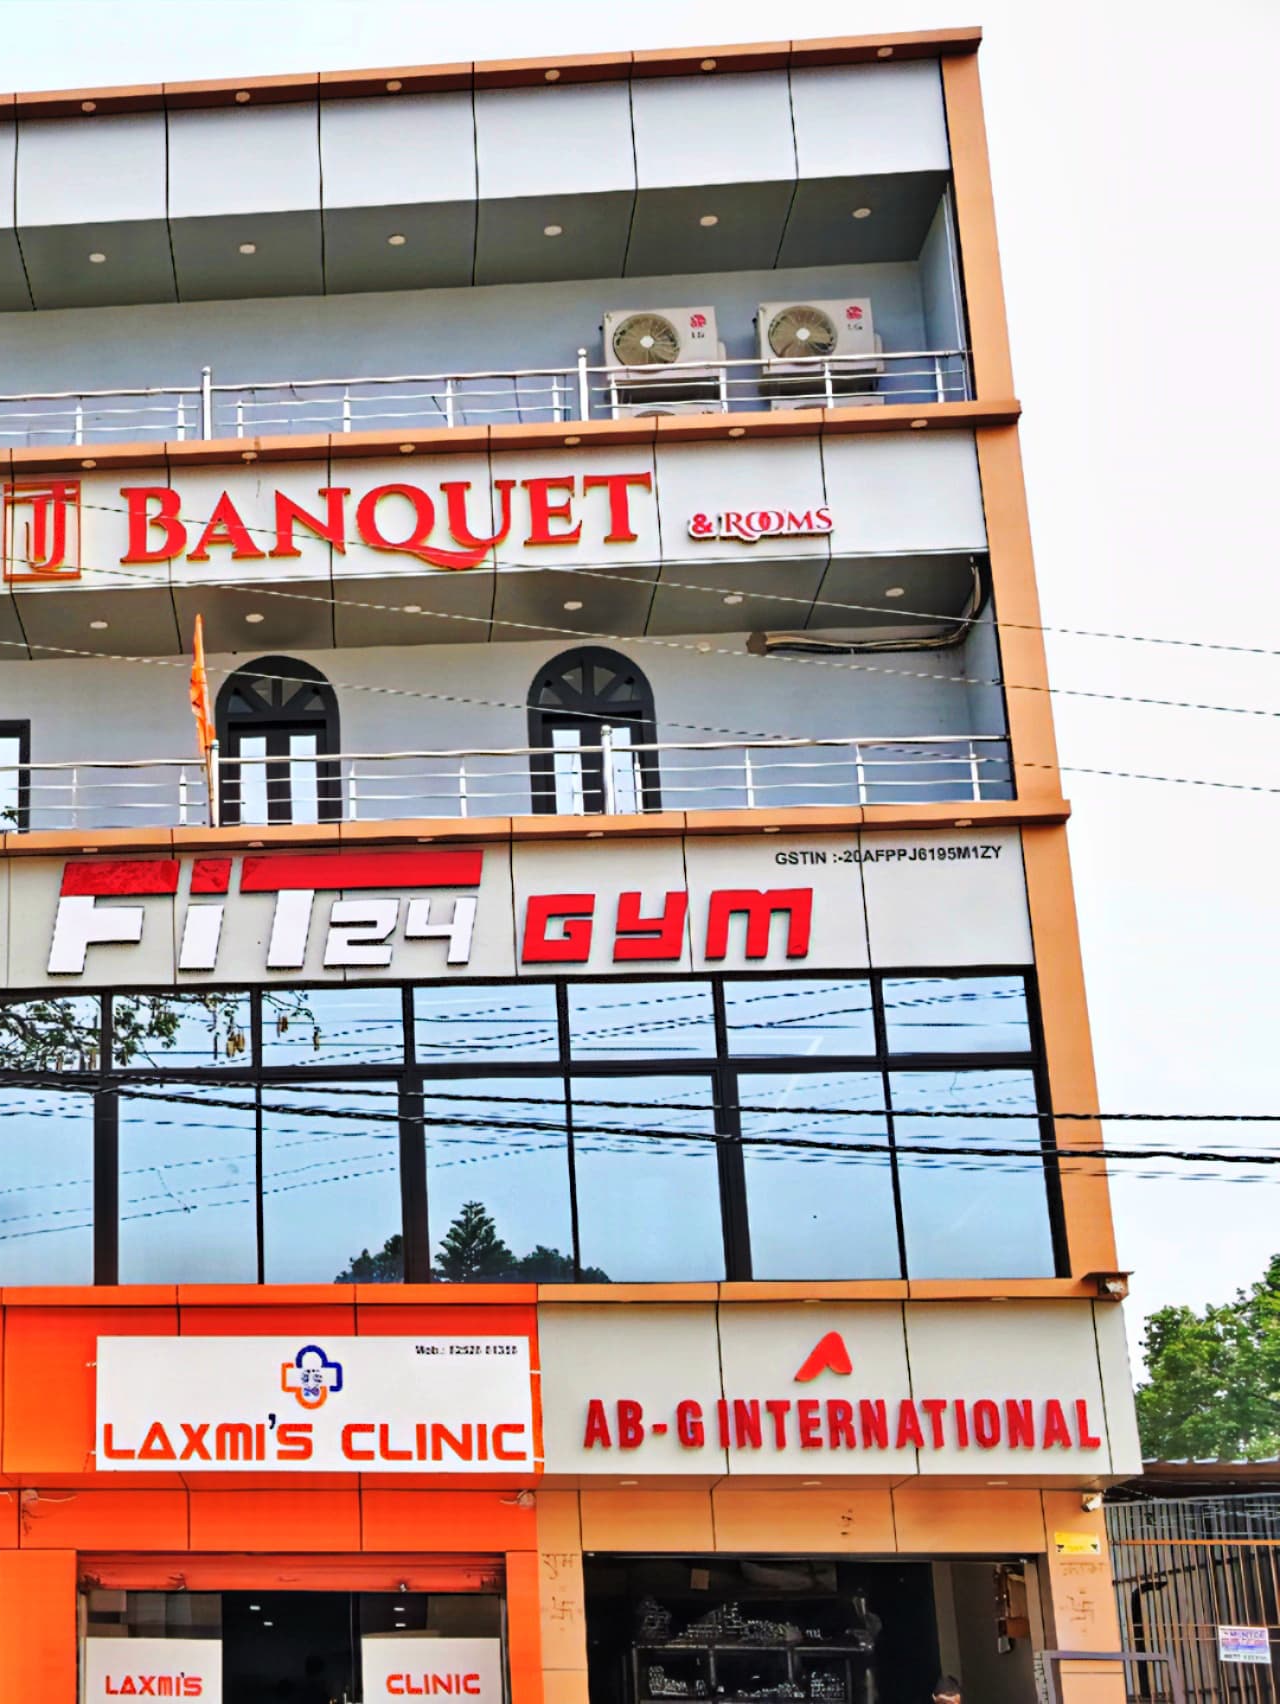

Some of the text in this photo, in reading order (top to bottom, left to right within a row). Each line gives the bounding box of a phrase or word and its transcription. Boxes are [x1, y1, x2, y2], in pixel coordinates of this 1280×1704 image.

[120, 472, 652, 570] BANQUET
[691, 513, 713, 534] &
[724, 507, 833, 537] ROOMS
[775, 851, 827, 866] GSTIN
[521, 887, 814, 963] GYM
[104, 1414, 528, 1462] LAXMI'S CLINIC
[718, 1398, 1102, 1451] INTERNATIONAL
[105, 1671, 482, 1697] LAXMI'S CLINIC
